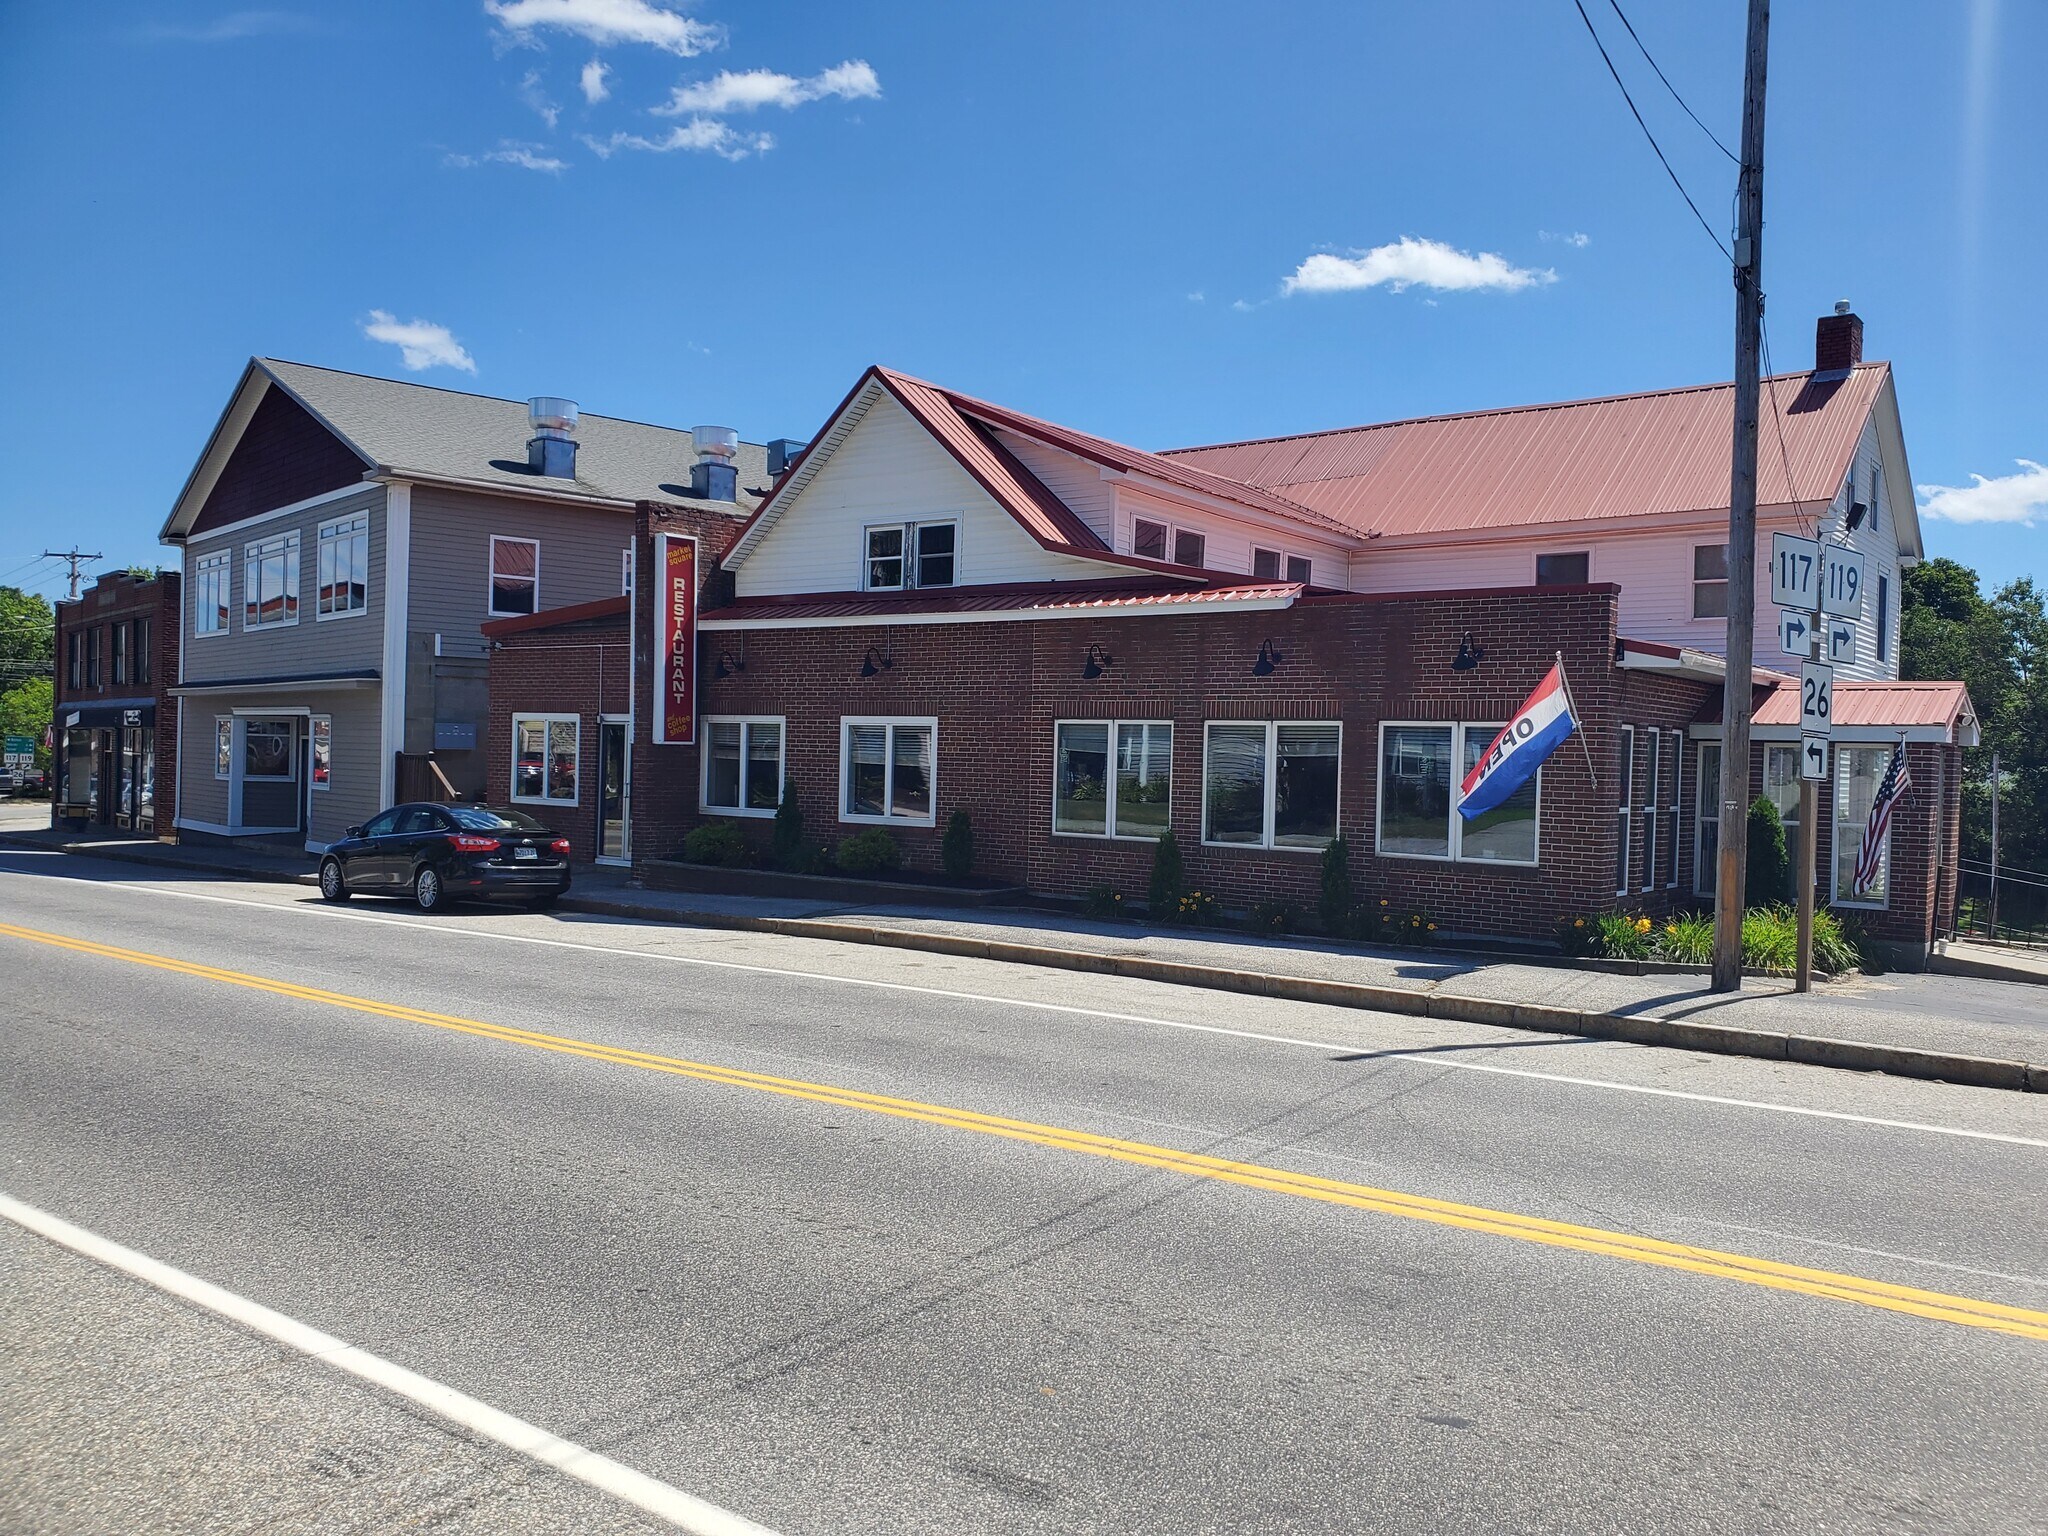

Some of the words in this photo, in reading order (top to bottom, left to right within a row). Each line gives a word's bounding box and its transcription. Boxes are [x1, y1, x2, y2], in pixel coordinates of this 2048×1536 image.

[667, 545, 692, 560] market
[669, 553, 693, 566] square
[1780, 551, 1812, 592] 117
[1830, 562, 1859, 603] 119
[672, 578, 684, 704] RESTAURANT
[1804, 678, 1829, 718] 26
[668, 715, 691, 729] coffee
[669, 725, 688, 737] shop
